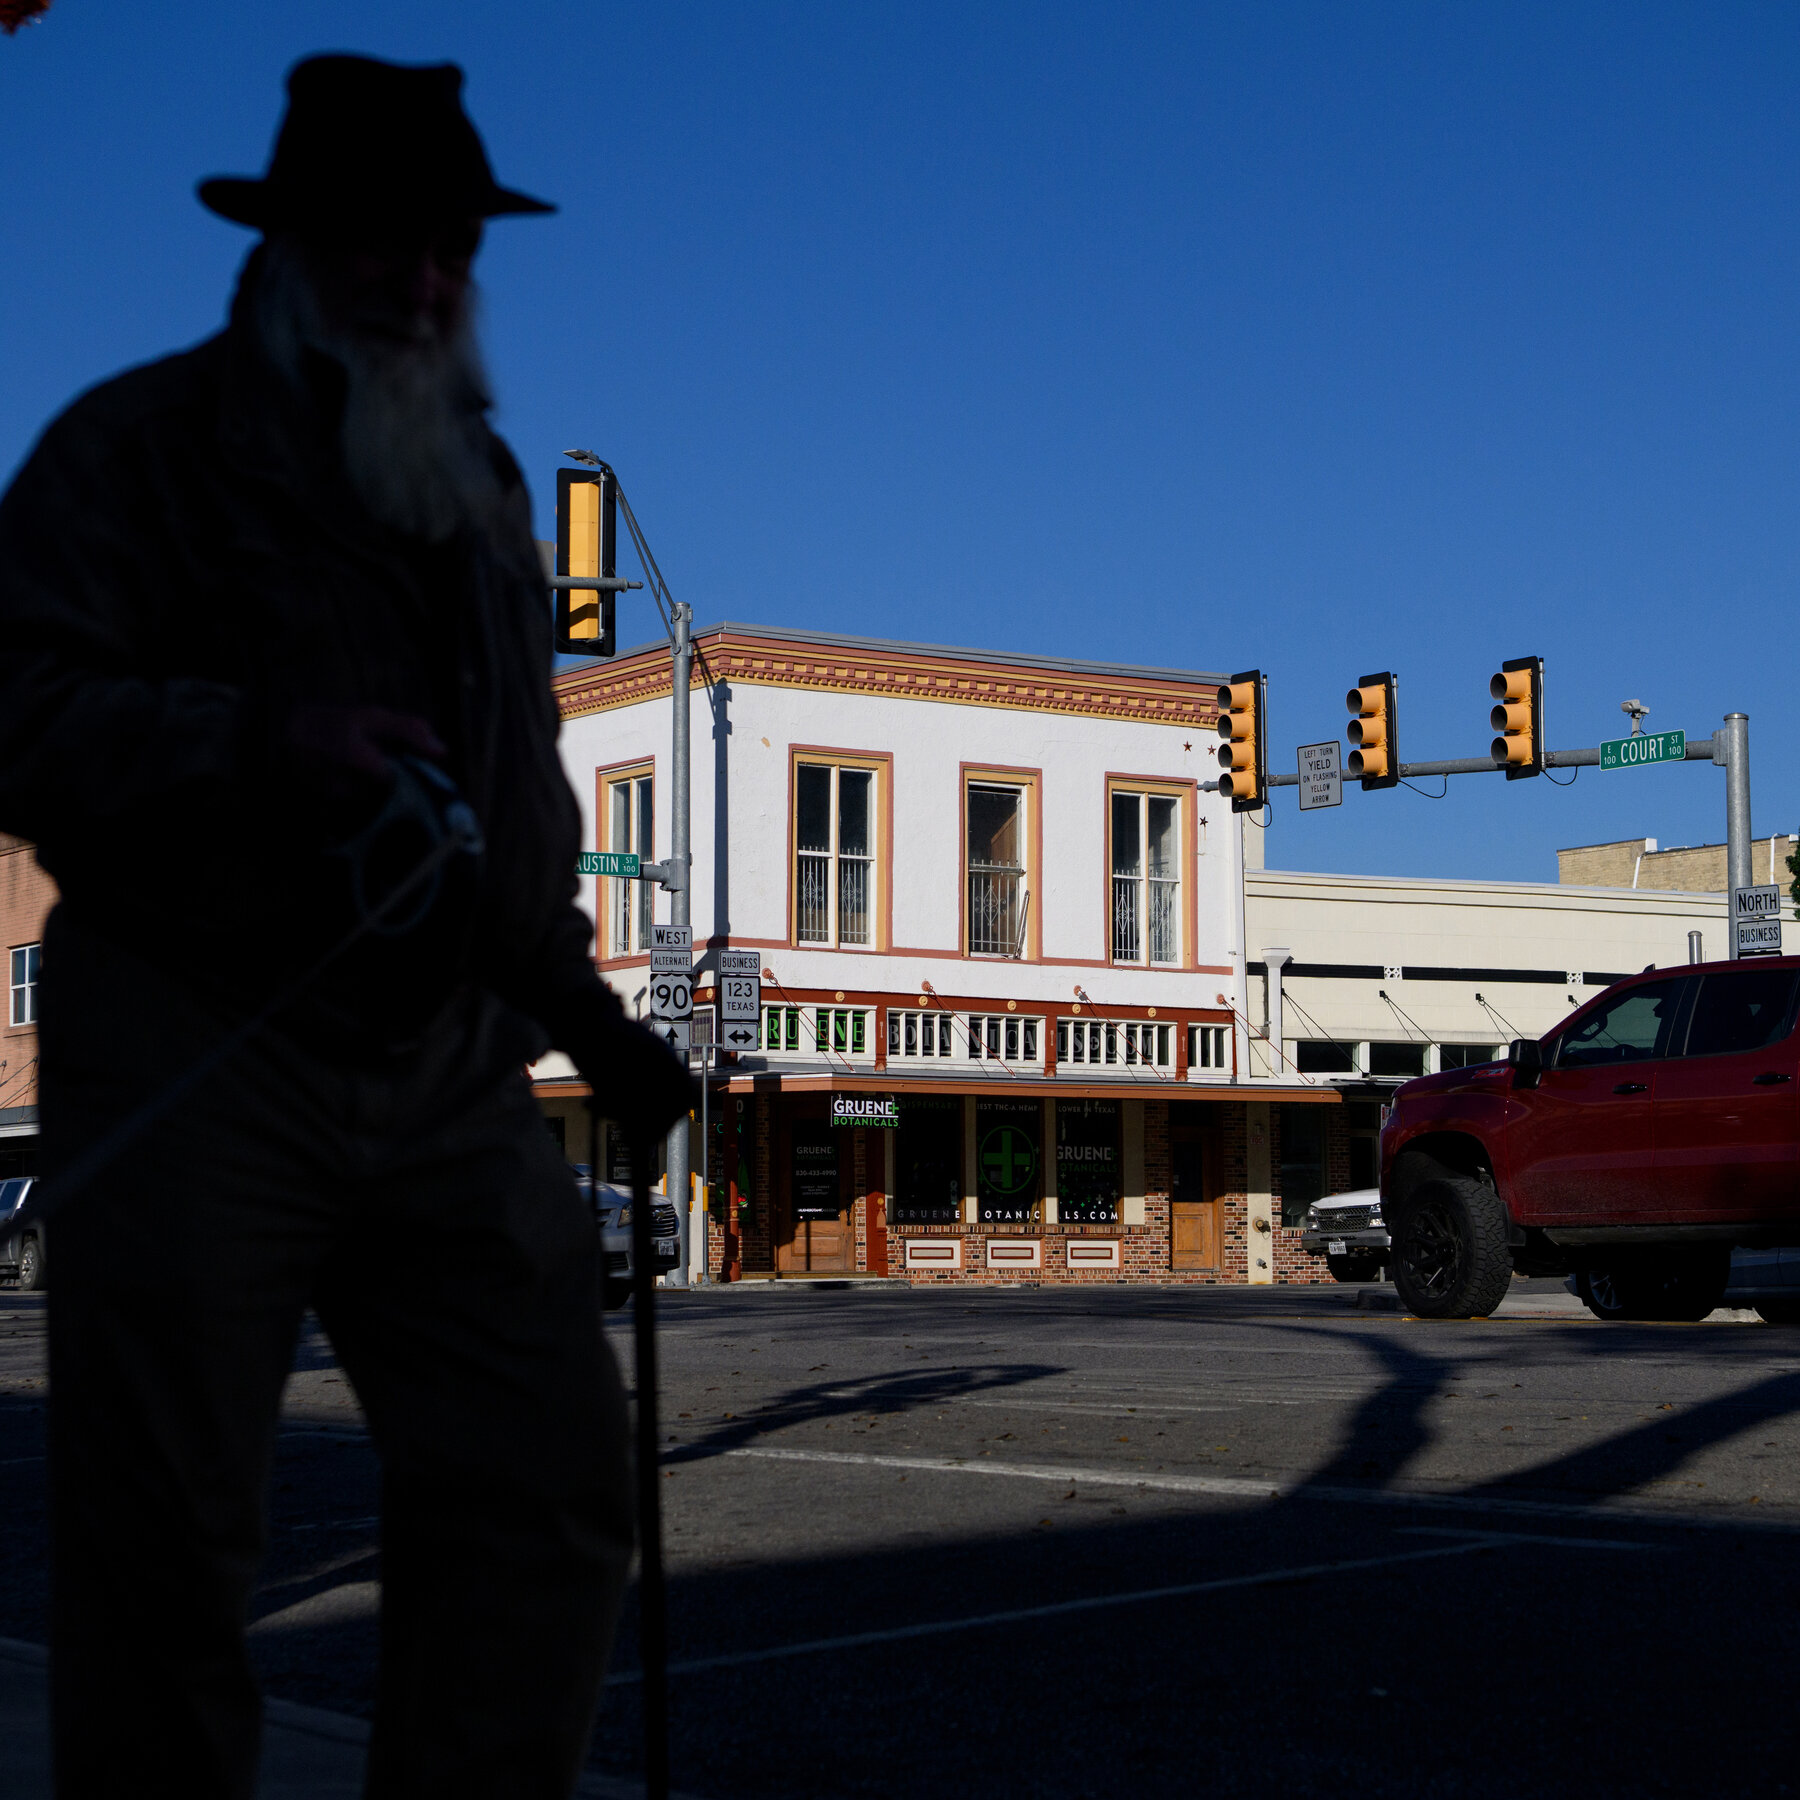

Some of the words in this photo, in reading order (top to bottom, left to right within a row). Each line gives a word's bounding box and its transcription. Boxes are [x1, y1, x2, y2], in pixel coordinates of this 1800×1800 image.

[1304, 750, 1316, 758] LEFT
[1319, 748, 1333, 756] TURN
[1621, 737, 1664, 764] COURT
[1672, 735, 1679, 744] ST
[1669, 745, 1682, 755] 100
[1308, 758, 1331, 771] YIELD
[1604, 756, 1617, 765] 100
[1303, 775, 1311, 783] ON
[1313, 771, 1337, 781] FLASHING
[1311, 783, 1330, 793] YELLOW
[1312, 795, 1329, 804] ARROW
[576, 855, 619, 873] AUSTIN
[623, 865, 636, 873] 100
[1738, 893, 1777, 912] NORTH
[655, 929, 687, 945] WEST
[1740, 926, 1778, 943] BUSINESS
[654, 956, 689, 966] ALTERNATE
[722, 957, 758, 969] BUSINESS
[728, 982, 753, 997] 123
[656, 984, 689, 1009] 90
[727, 1002, 754, 1011] TEXAS
[833, 1099, 893, 1115] GRUENE
[833, 1116, 899, 1127] BOTANICALS
[796, 1146, 832, 1155] GRUENE
[1057, 1146, 1113, 1161] GRUENE
[897, 1209, 961, 1218] GRUENE
